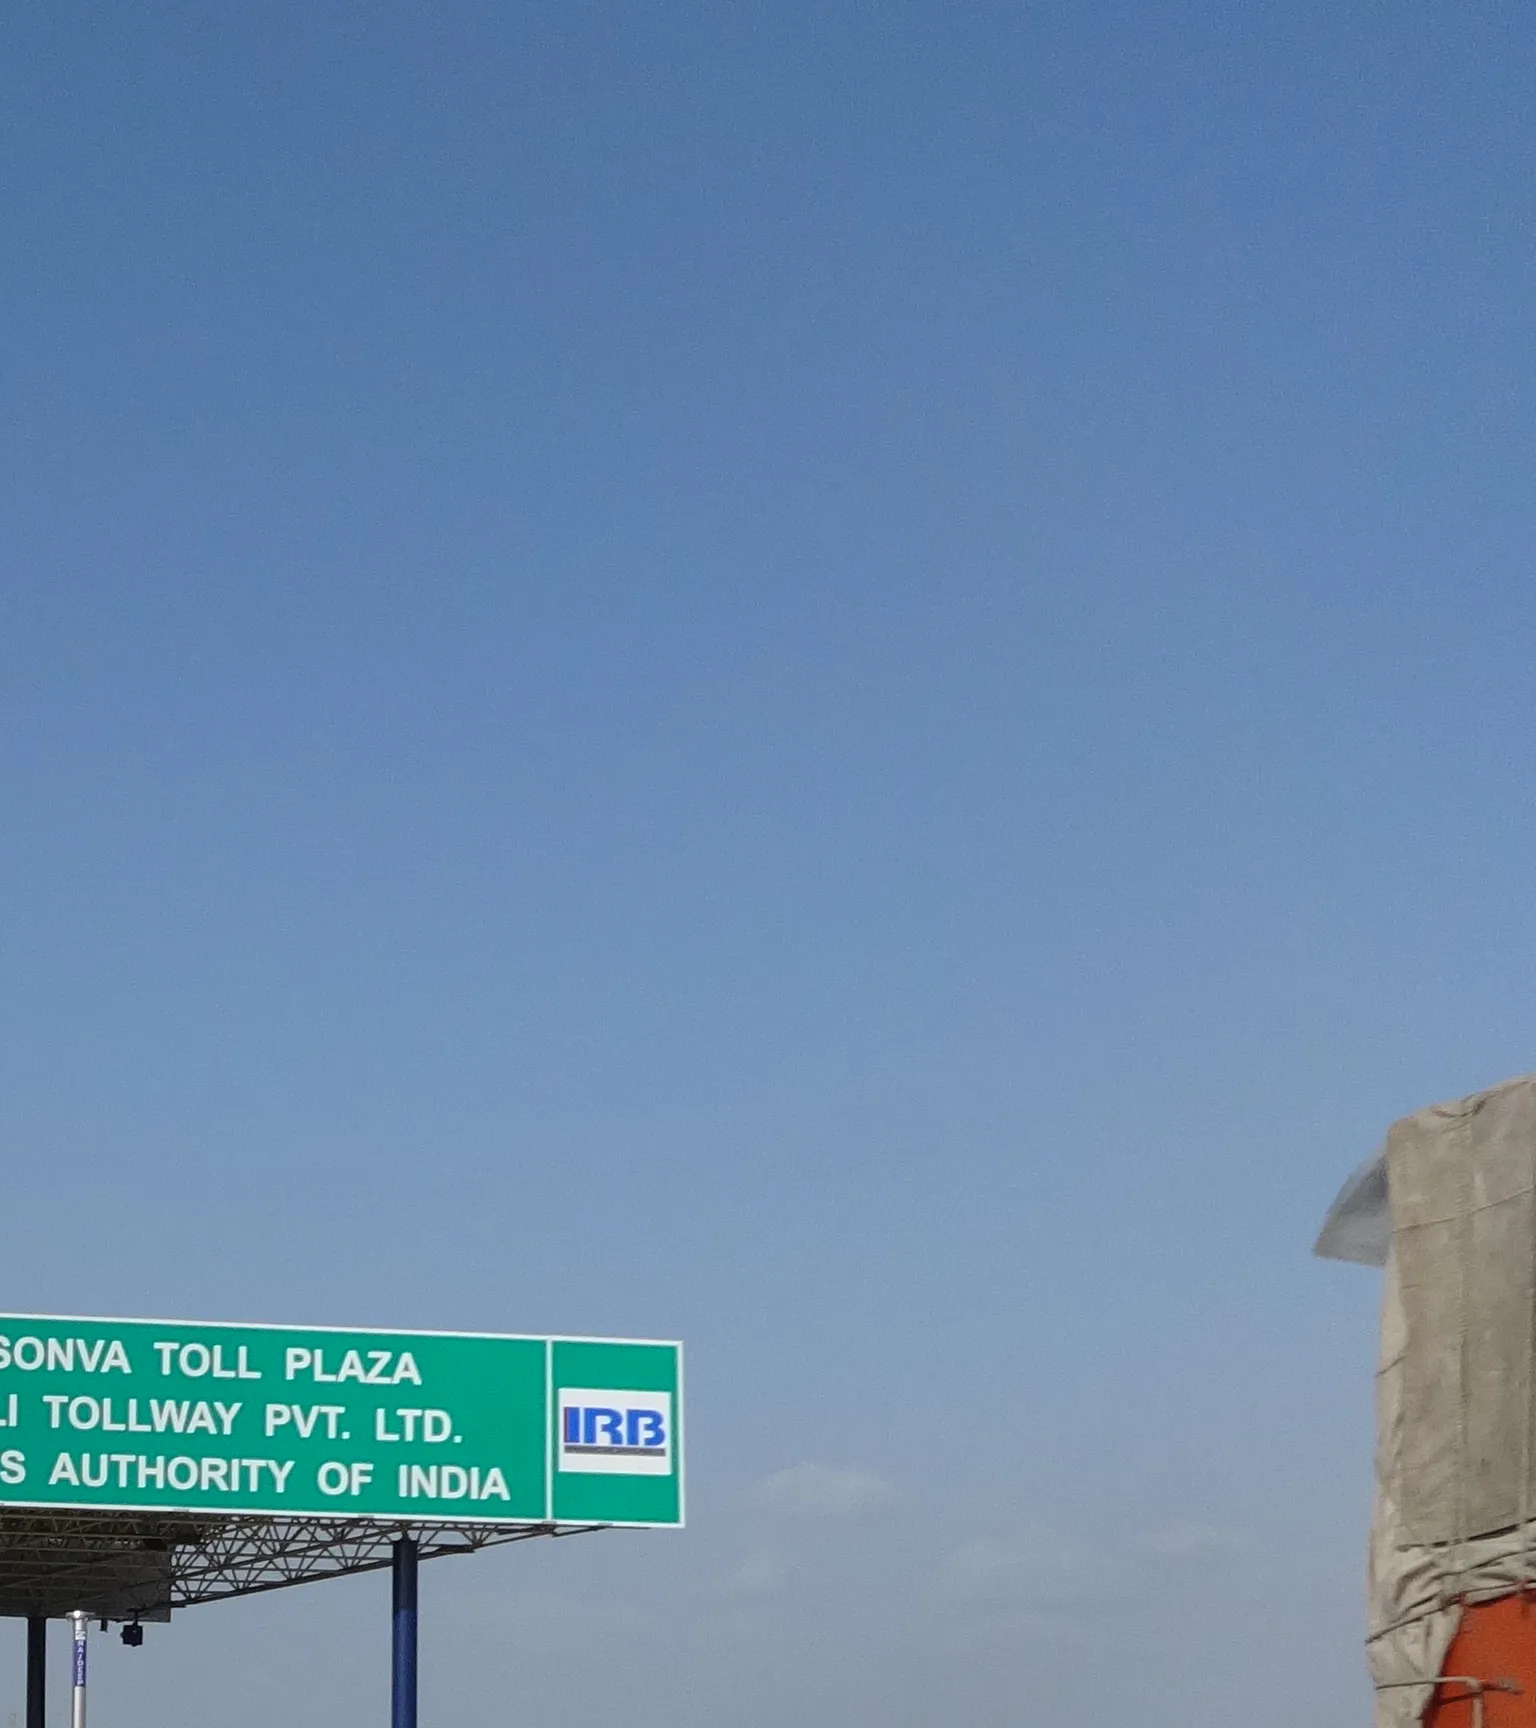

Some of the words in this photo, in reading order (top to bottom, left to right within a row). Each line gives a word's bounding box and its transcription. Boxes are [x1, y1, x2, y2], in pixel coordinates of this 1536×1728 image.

[154, 1341, 261, 1380] TOLL
[284, 1348, 423, 1385] PLAZA
[42, 1394, 243, 1437] TOLLWAY
[265, 1404, 351, 1441] PVT.
[375, 1408, 463, 1444] LTD.
[563, 1406, 666, 1447] IRB
[48, 1453, 296, 1495] AUTHORITY
[317, 1461, 374, 1498] OF
[398, 1464, 511, 1502] INDIA
